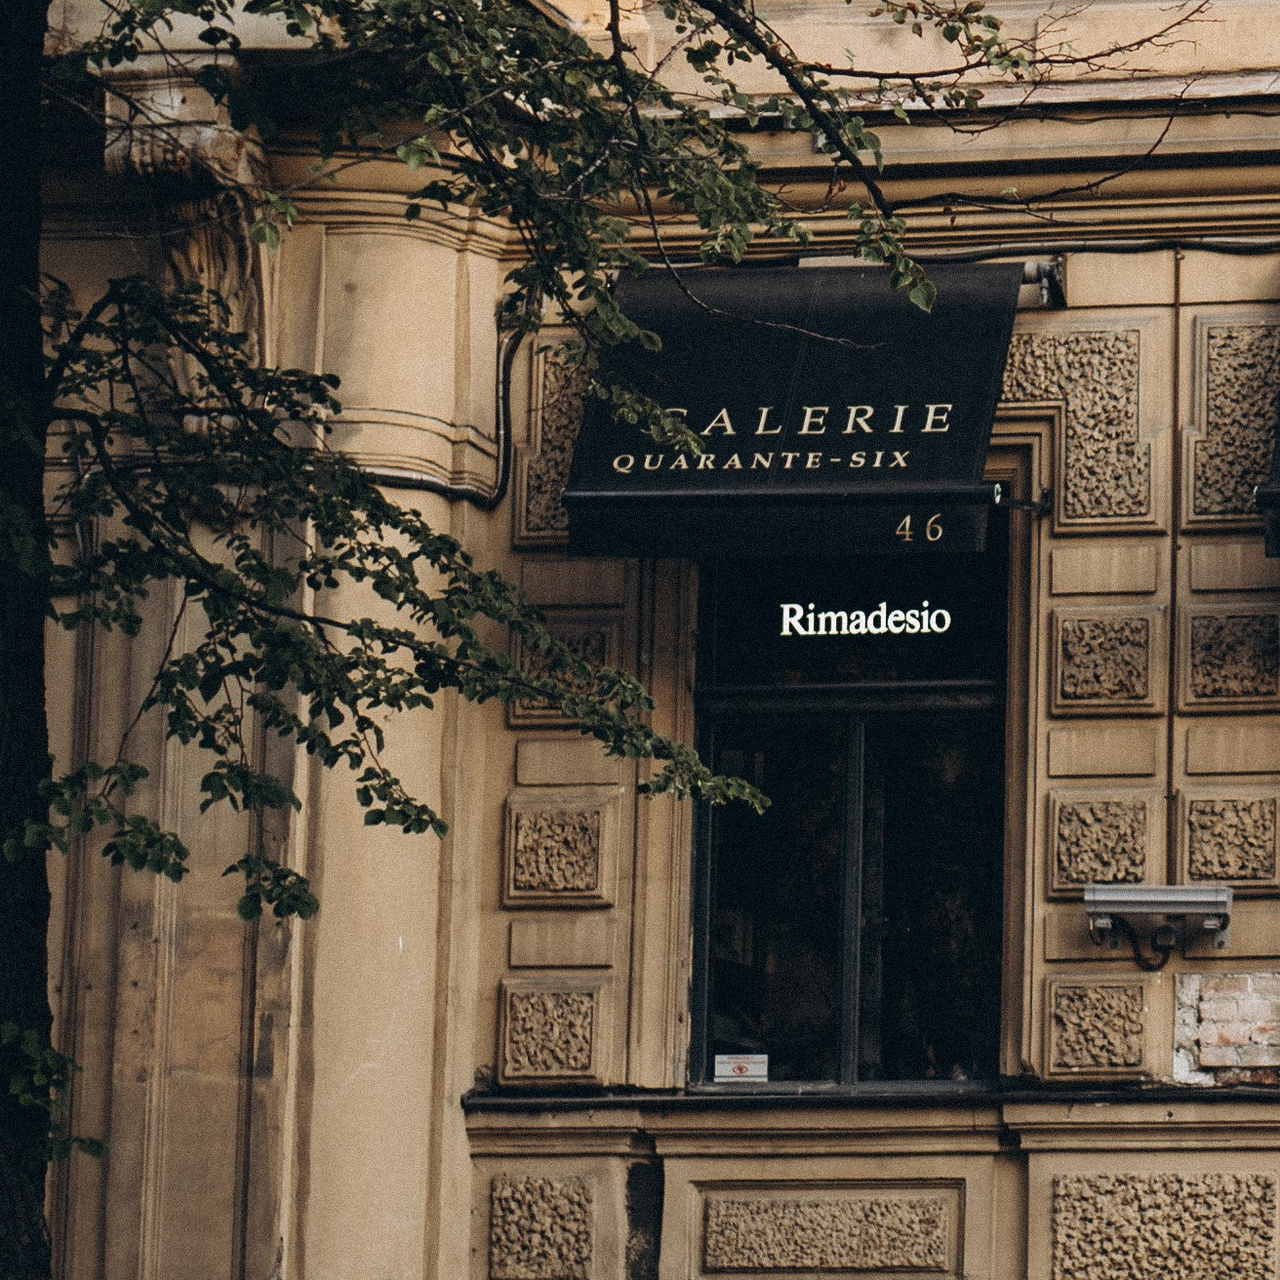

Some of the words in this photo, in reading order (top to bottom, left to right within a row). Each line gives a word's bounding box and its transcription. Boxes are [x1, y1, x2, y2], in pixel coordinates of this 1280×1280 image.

[612, 451, 910, 474] QUARANTE-SIX
[895, 513, 944, 542] 46
[780, 600, 952, 636] Rimadesio
